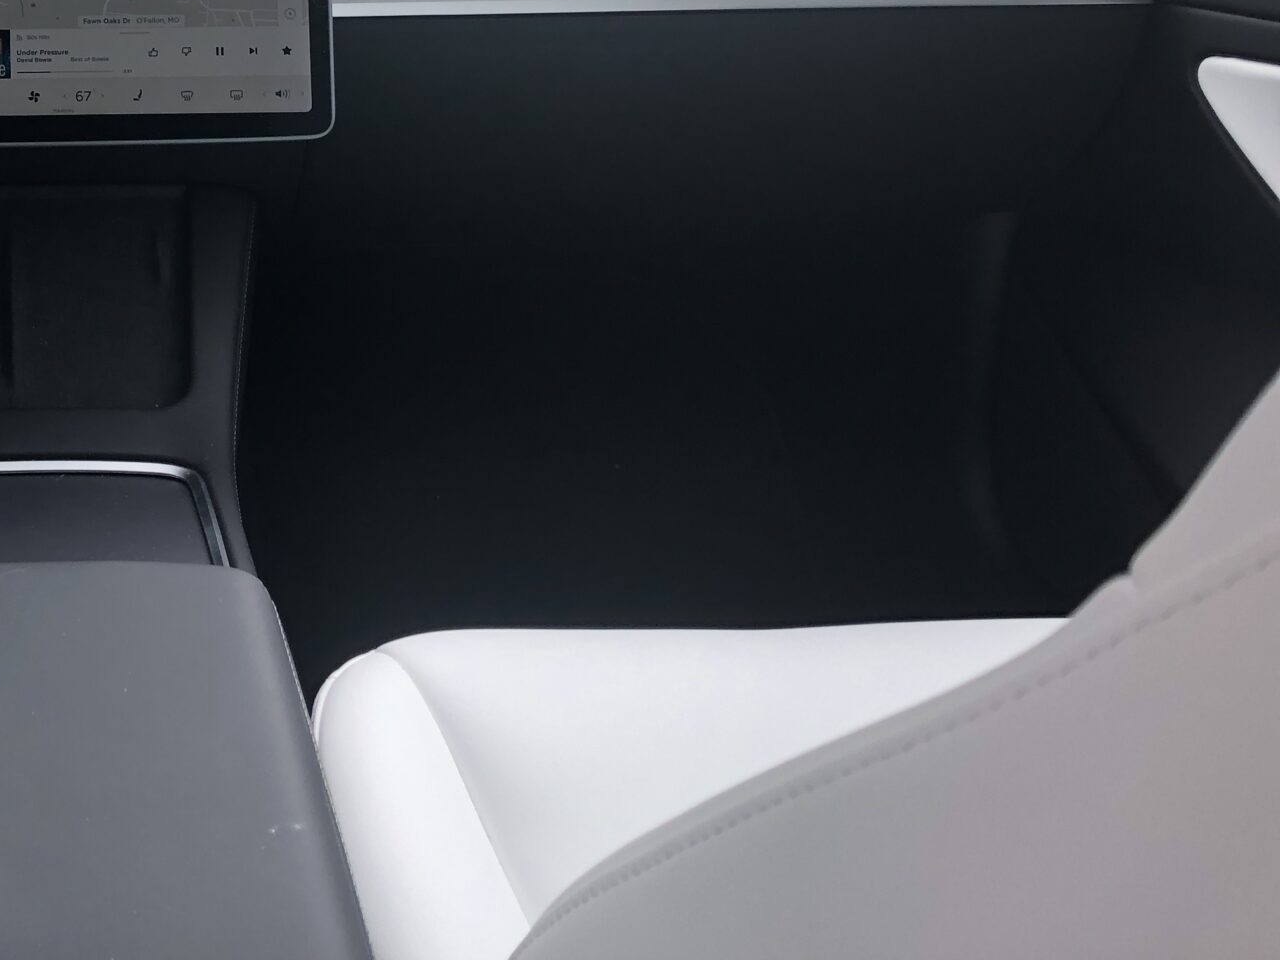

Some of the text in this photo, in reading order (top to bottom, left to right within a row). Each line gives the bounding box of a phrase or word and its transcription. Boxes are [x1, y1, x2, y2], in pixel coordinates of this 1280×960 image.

[82, 17, 102, 25] Fawn
[167, 16, 180, 24] MO
[75, 90, 92, 102] 67
